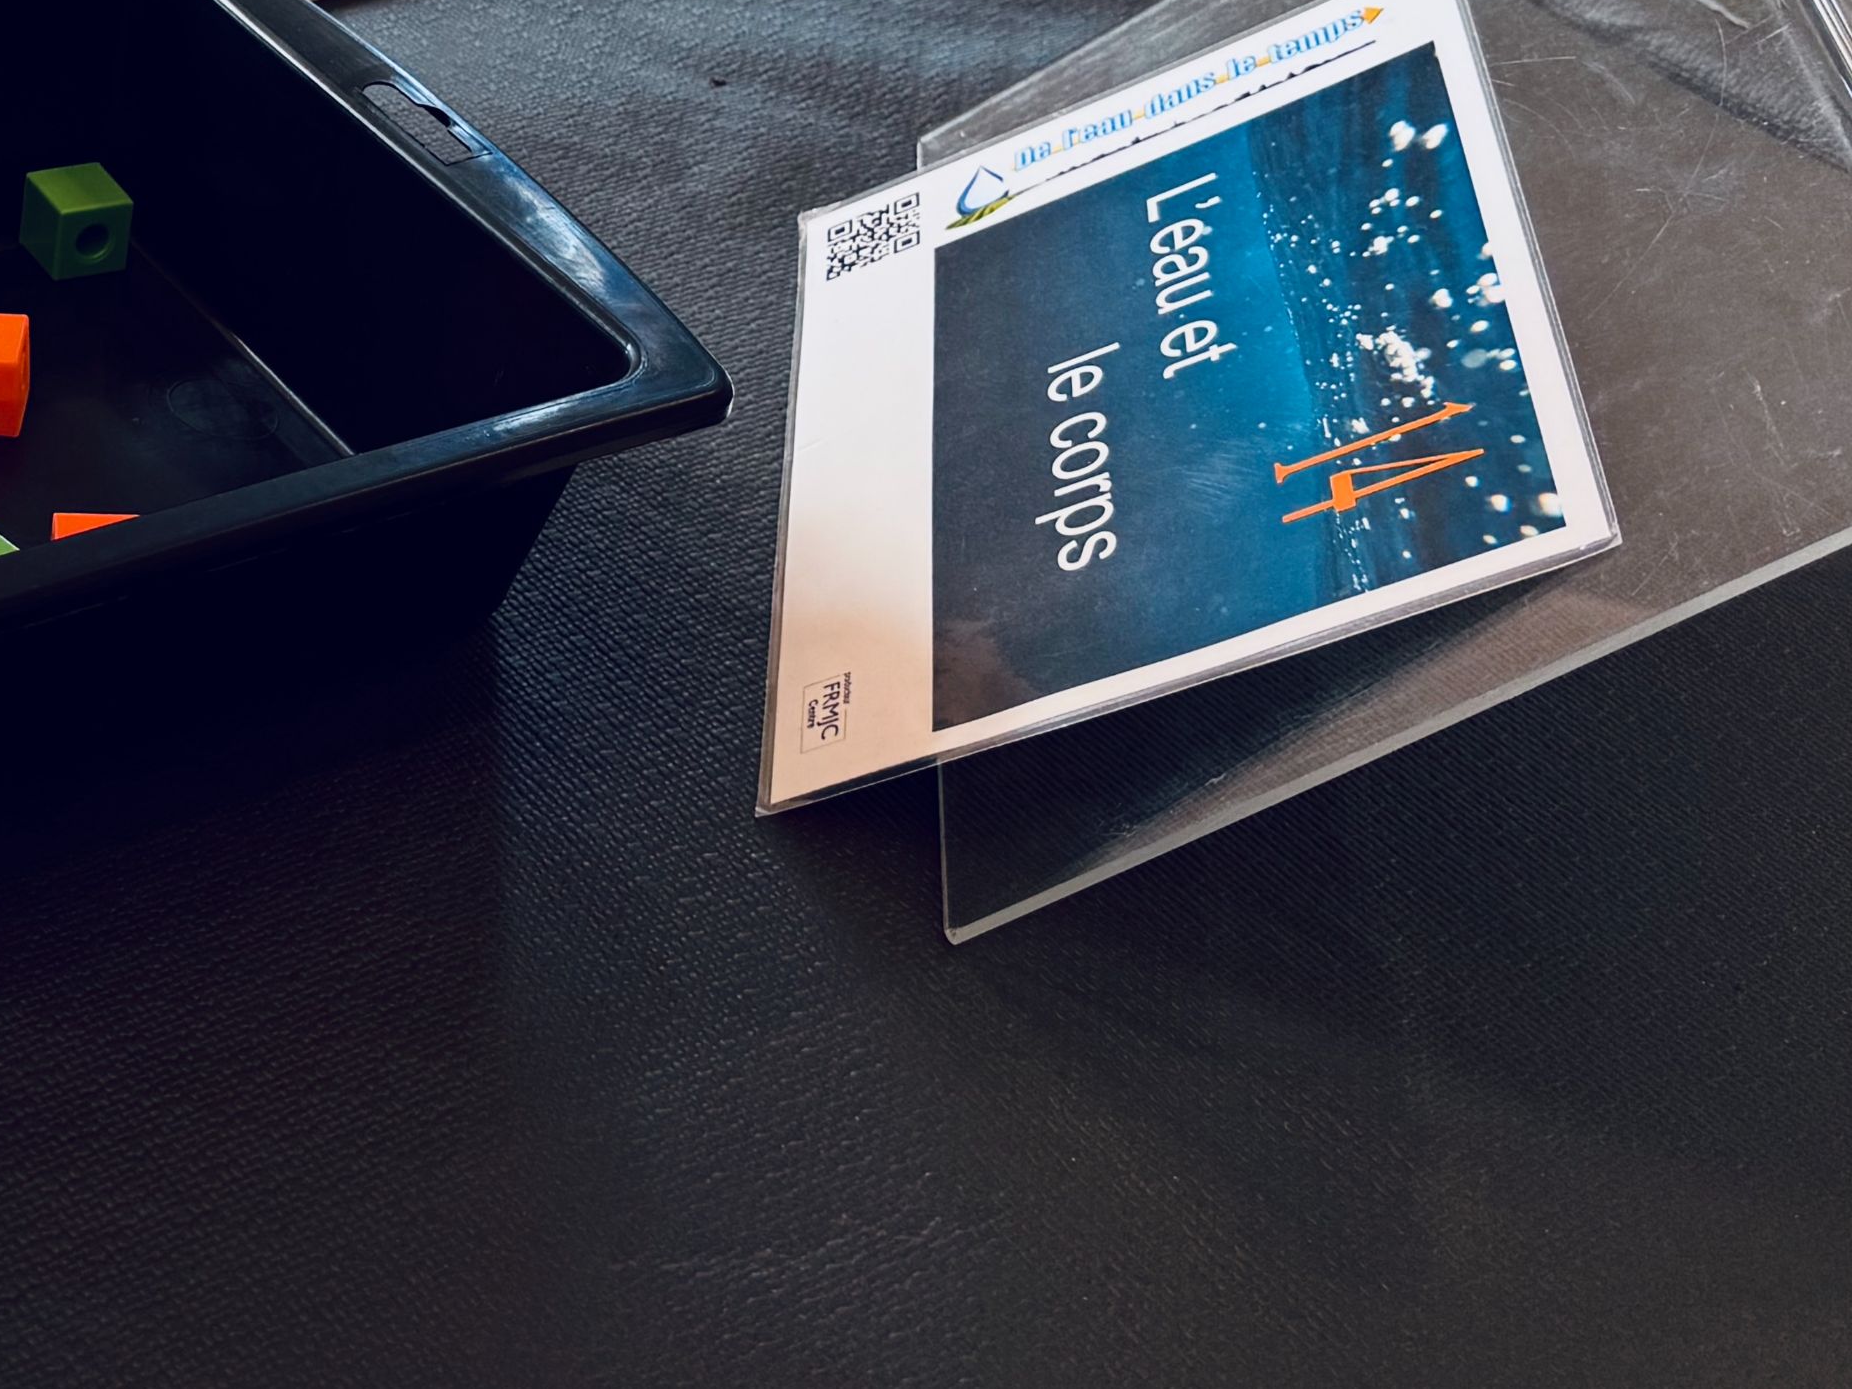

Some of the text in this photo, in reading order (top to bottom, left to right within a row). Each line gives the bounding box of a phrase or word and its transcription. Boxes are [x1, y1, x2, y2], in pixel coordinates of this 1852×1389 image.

[1014, 9, 1364, 171] De l'eau dans le temps
[1146, 171, 1238, 380] L'eau et
[1035, 341, 1121, 572] le corps
[817, 681, 841, 741] FRMJC
